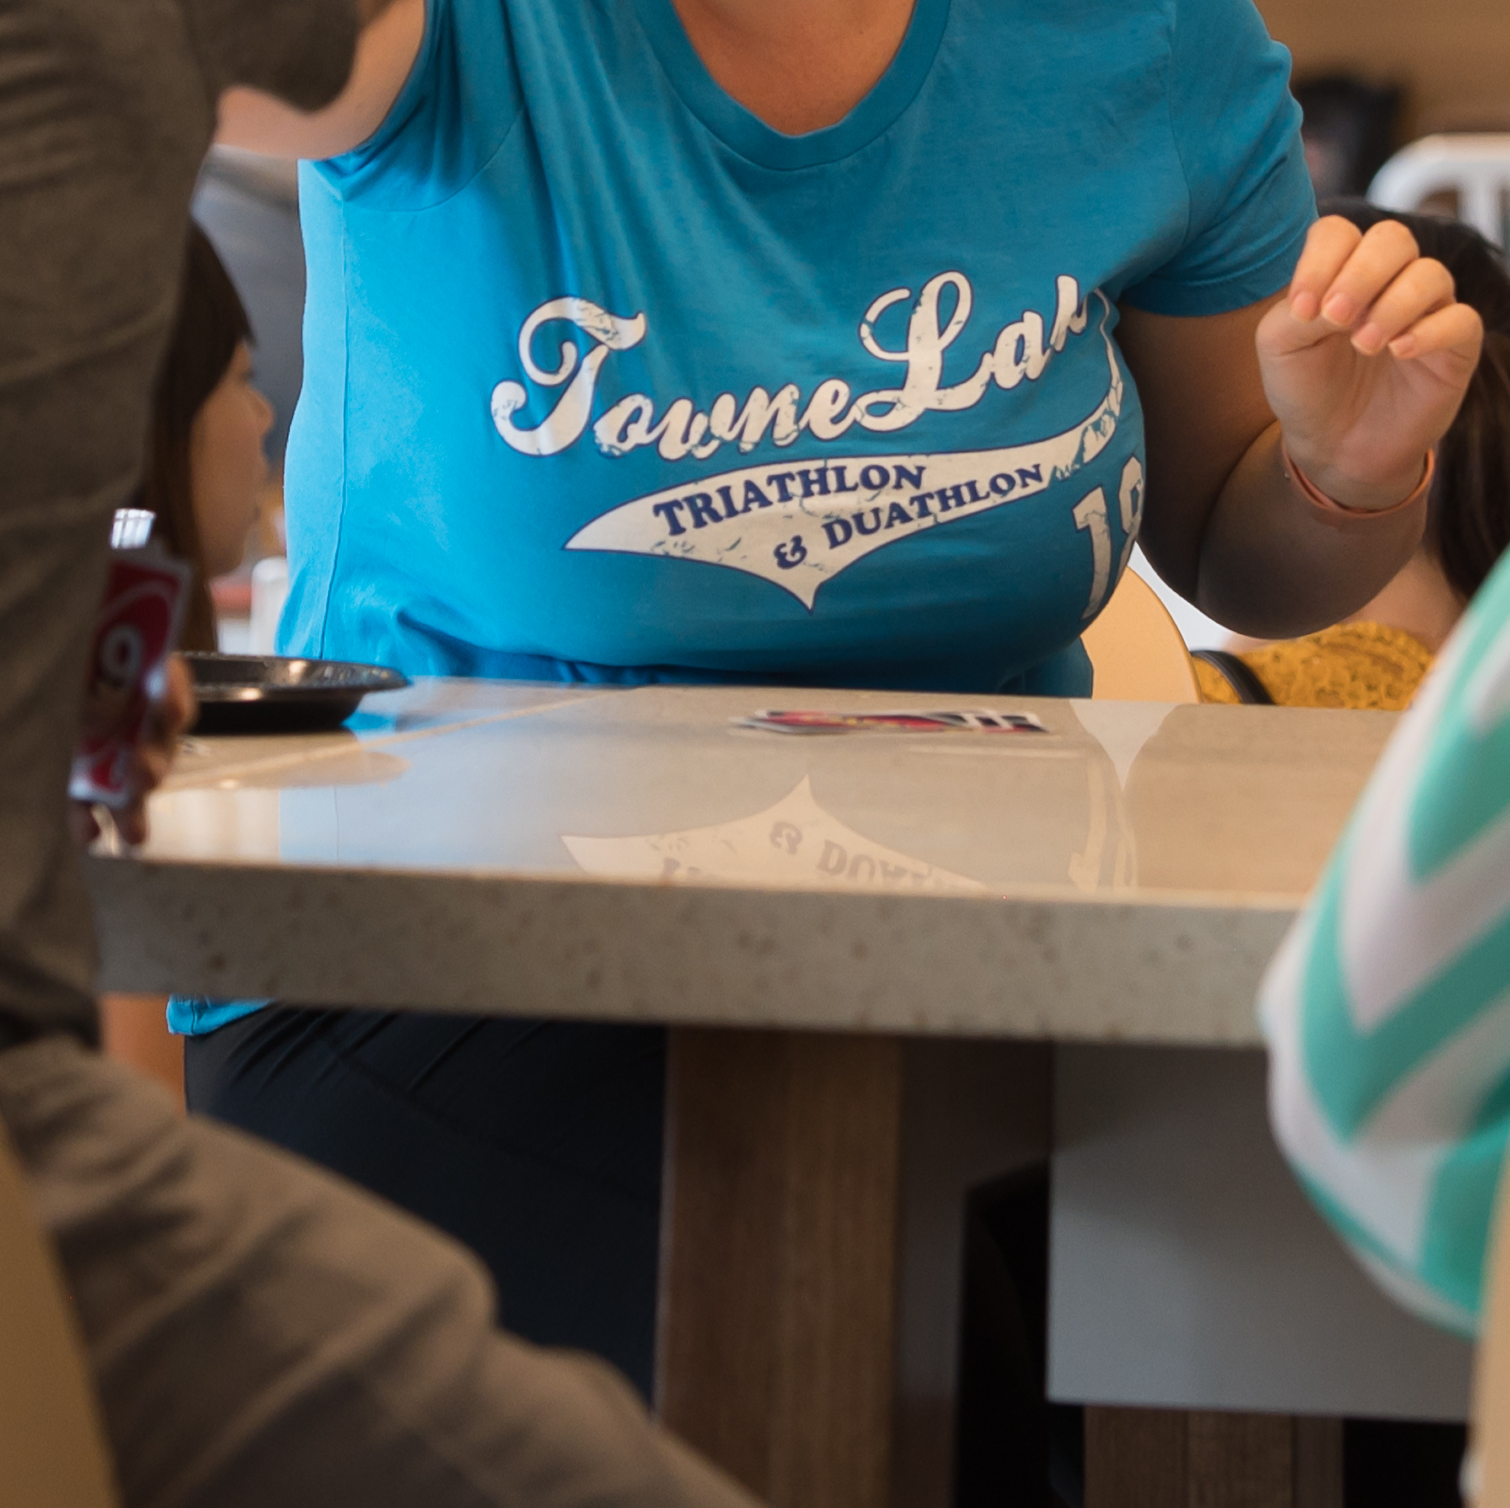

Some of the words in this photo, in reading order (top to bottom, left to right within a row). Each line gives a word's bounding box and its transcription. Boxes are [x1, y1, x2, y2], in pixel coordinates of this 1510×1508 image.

[653, 463, 926, 536] TRIATHLON
[773, 535, 808, 570] &
[821, 463, 1043, 550] DUATHLON
